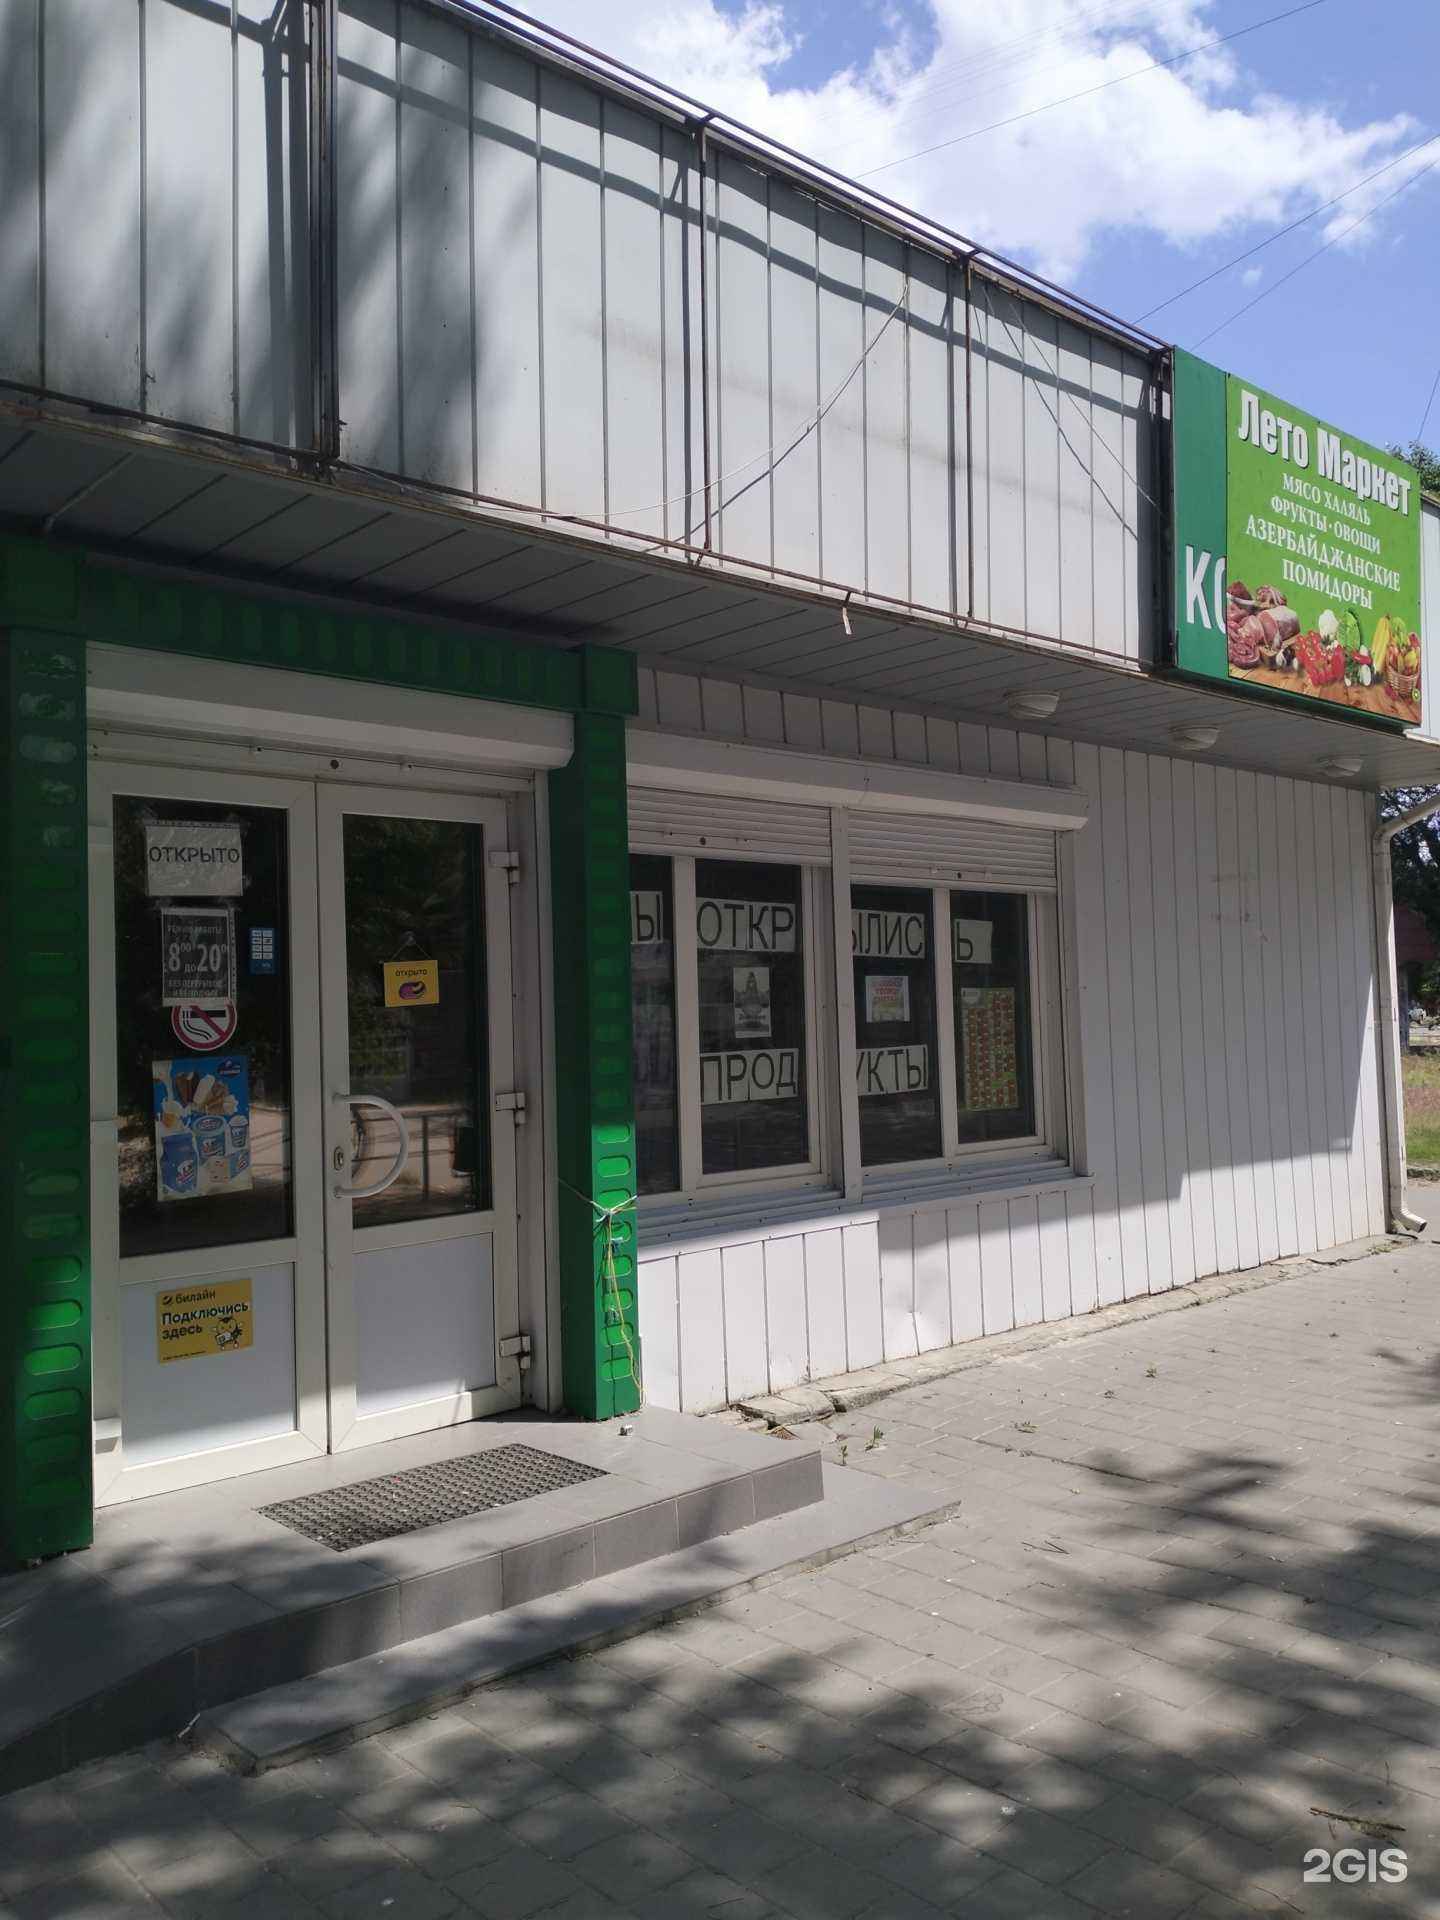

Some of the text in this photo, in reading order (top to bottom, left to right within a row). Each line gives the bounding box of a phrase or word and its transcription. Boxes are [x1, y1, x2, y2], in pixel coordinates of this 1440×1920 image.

[1238, 388, 1412, 517] Лето Маркет
[1270, 495, 1381, 555] ФРУКТЫ ОВОЩИ
[1283, 472, 1371, 526] МЯСО ХАЛЯЛЬ
[1245, 513, 1401, 592] АЗЕРБАЙДЖАНСКИЕ
[1282, 558, 1373, 610] ПОМИДОРЫ
[149, 846, 240, 864] ОТКРЫТО
[696, 900, 795, 950] ОТКР
[699, 1051, 797, 1103] ПРОД
[162, 1302, 249, 1326] Подключись
[175, 1288, 217, 1305] билайн
[162, 1325, 203, 1341] здесь
